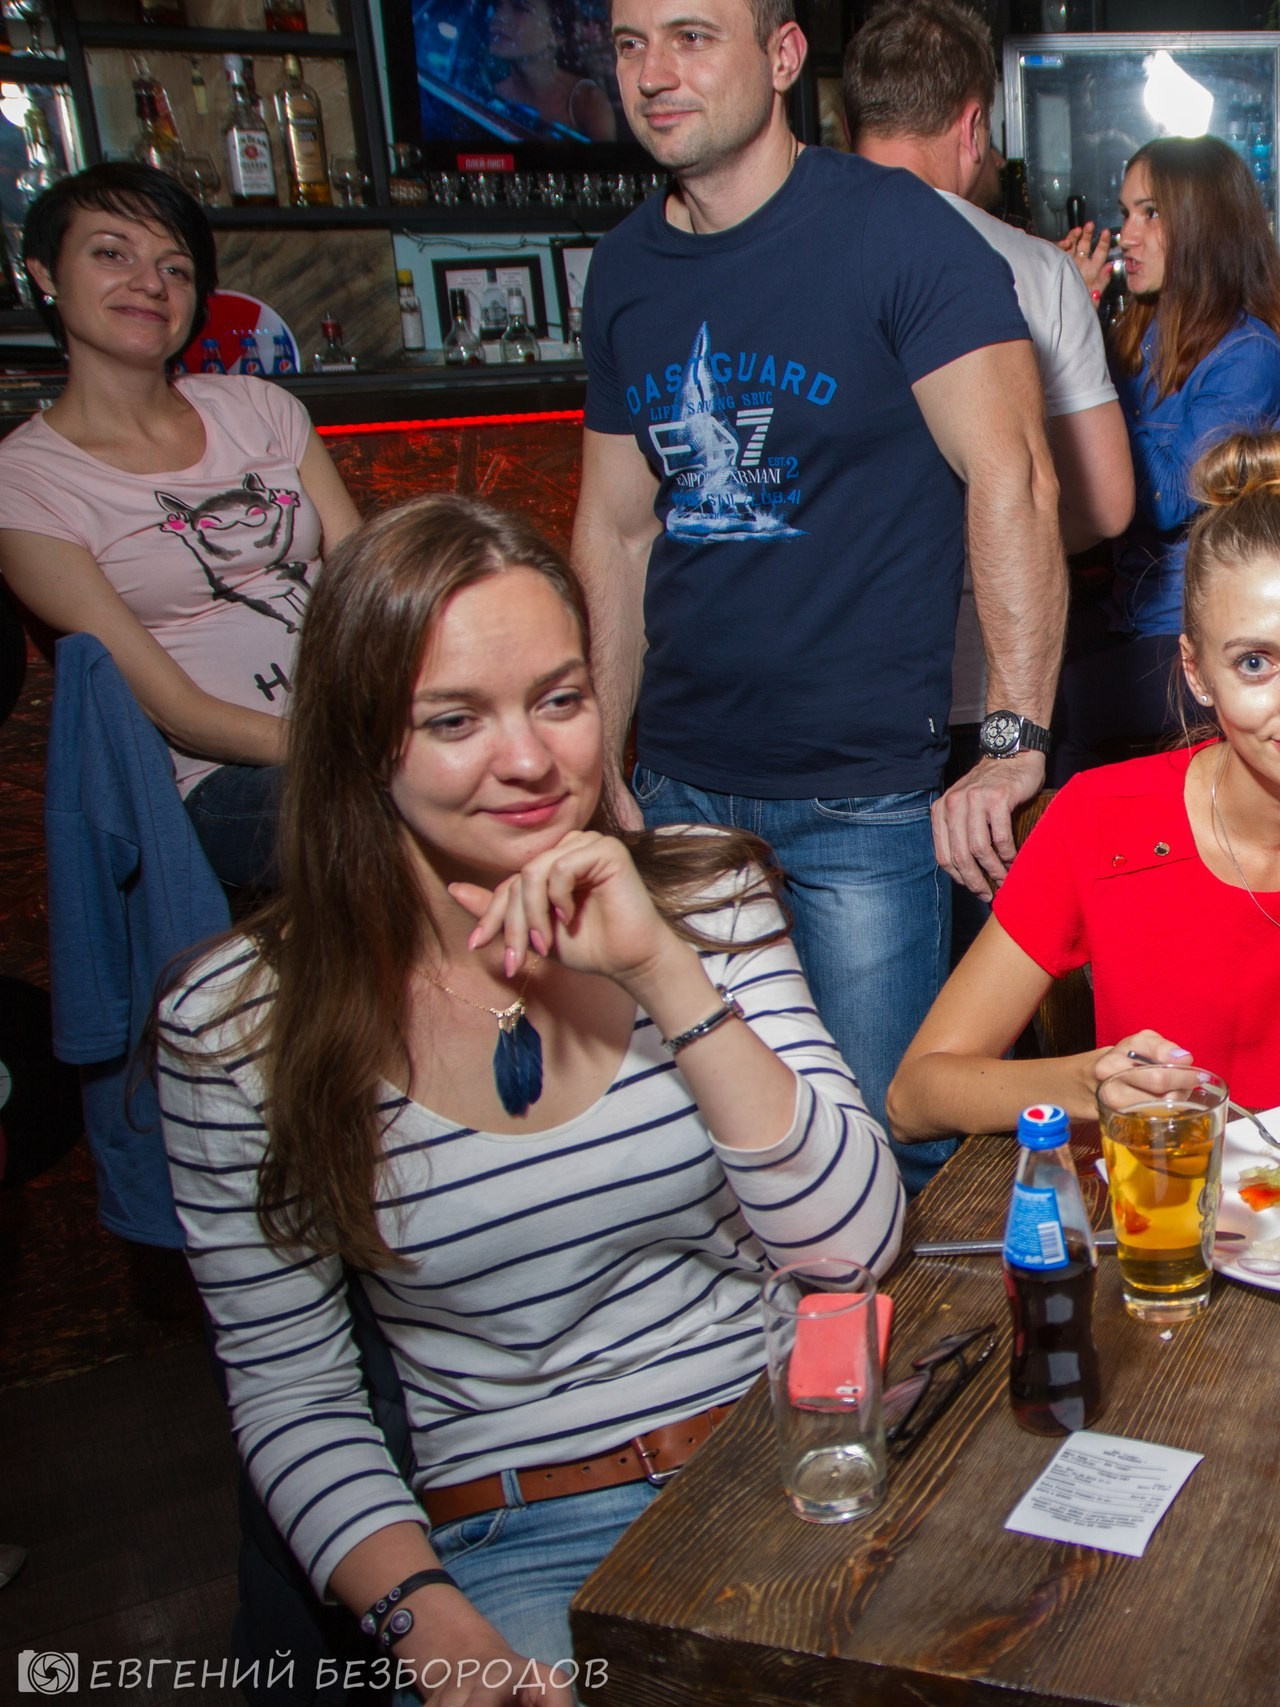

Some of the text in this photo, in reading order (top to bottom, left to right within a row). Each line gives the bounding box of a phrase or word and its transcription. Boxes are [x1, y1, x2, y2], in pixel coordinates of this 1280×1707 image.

[711, 352, 838, 405] GUARD
[650, 391, 773, 421] LIF SAVNG SRVC
[727, 468, 781, 488] ARMANI
